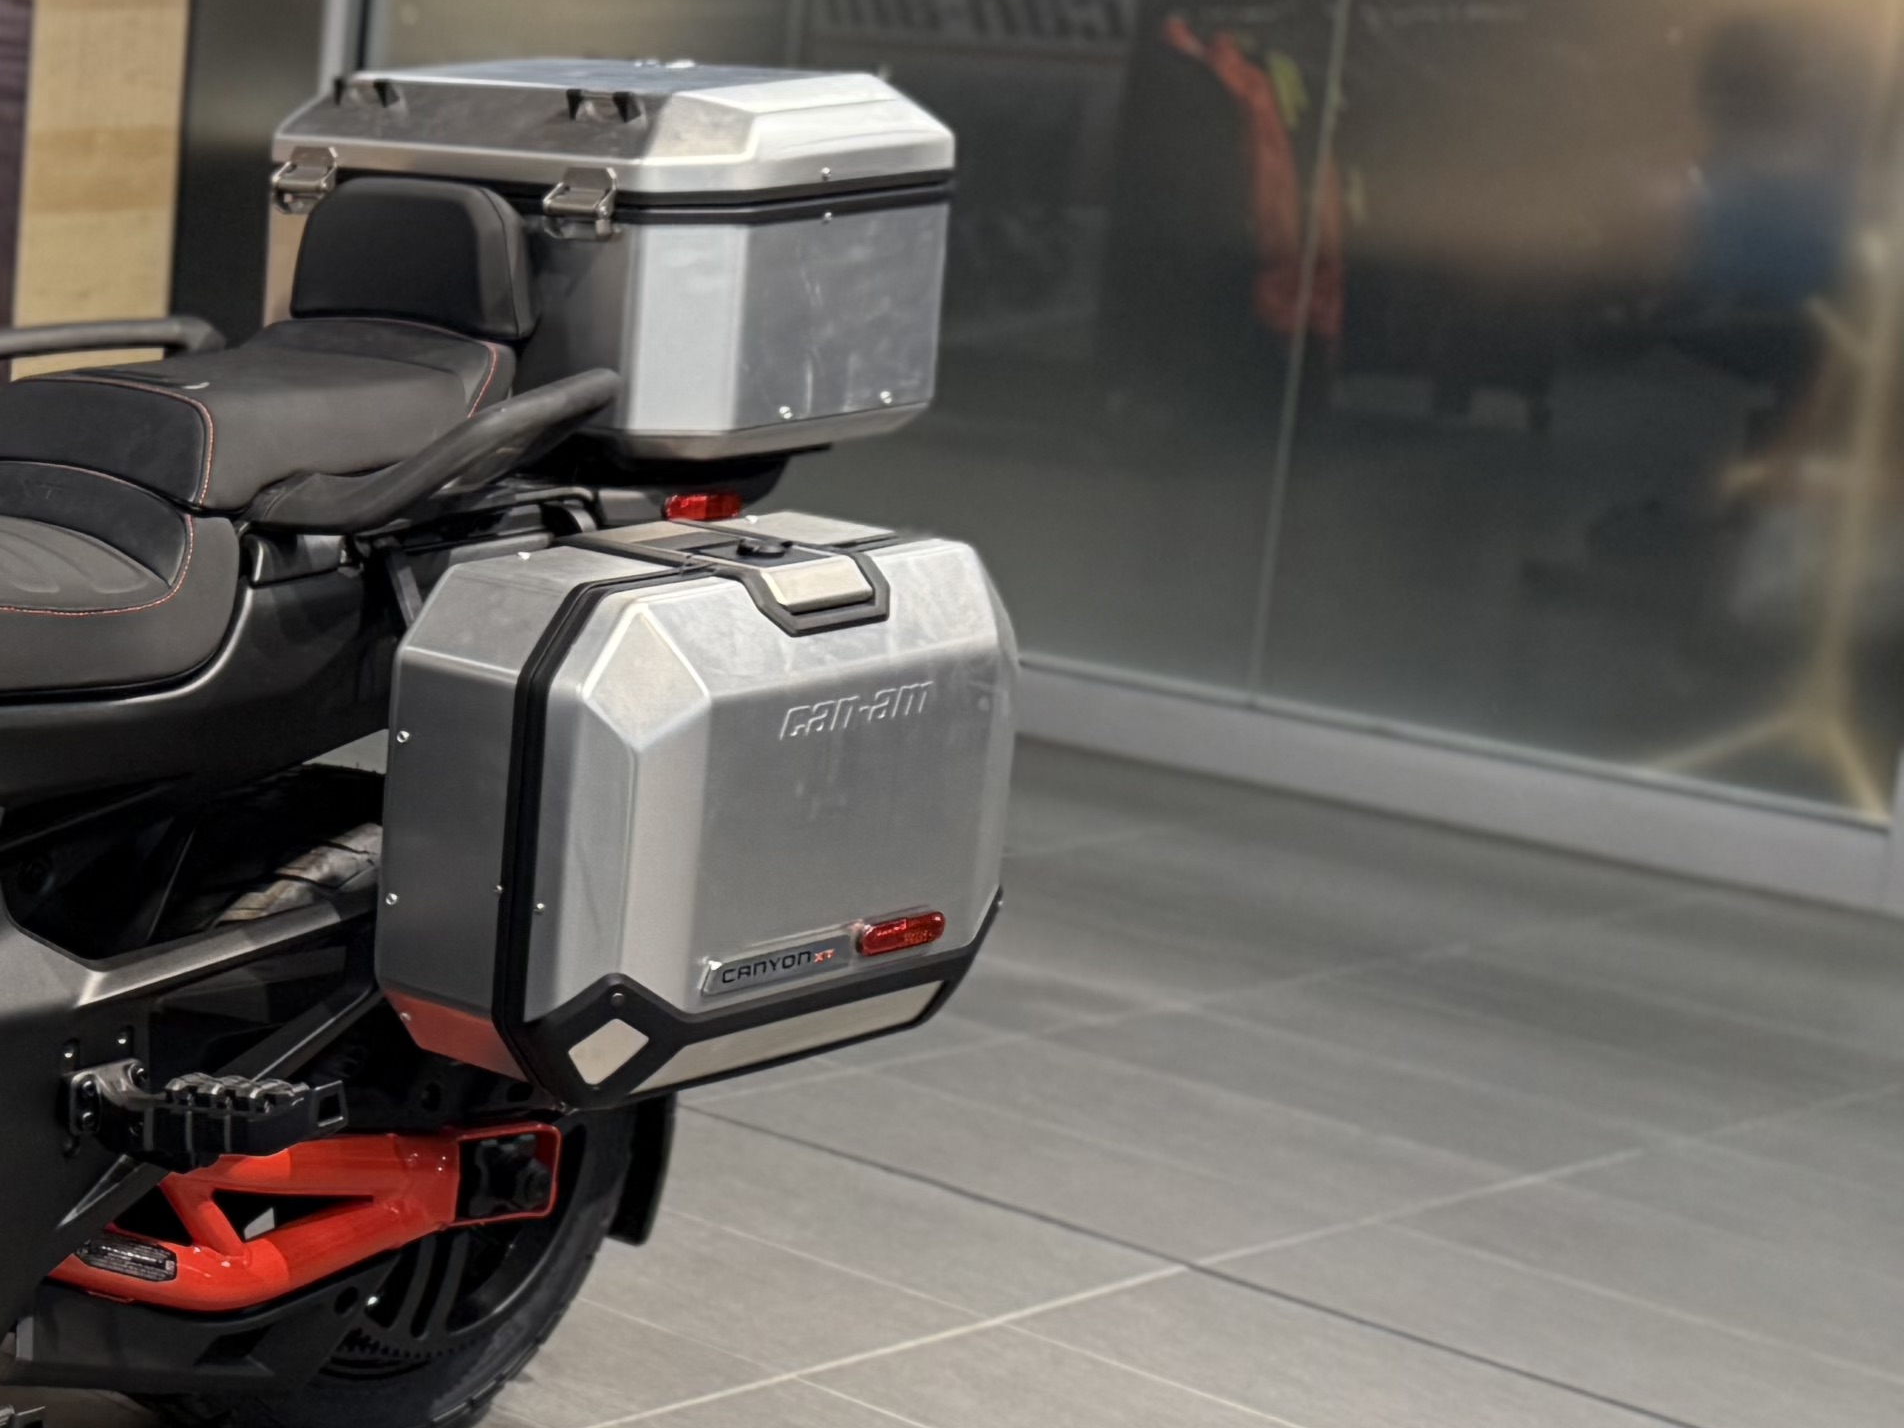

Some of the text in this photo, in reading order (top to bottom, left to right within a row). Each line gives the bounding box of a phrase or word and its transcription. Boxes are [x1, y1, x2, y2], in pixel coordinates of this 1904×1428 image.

[778, 679, 937, 744] can-am
[721, 947, 836, 985] CANYON XT
